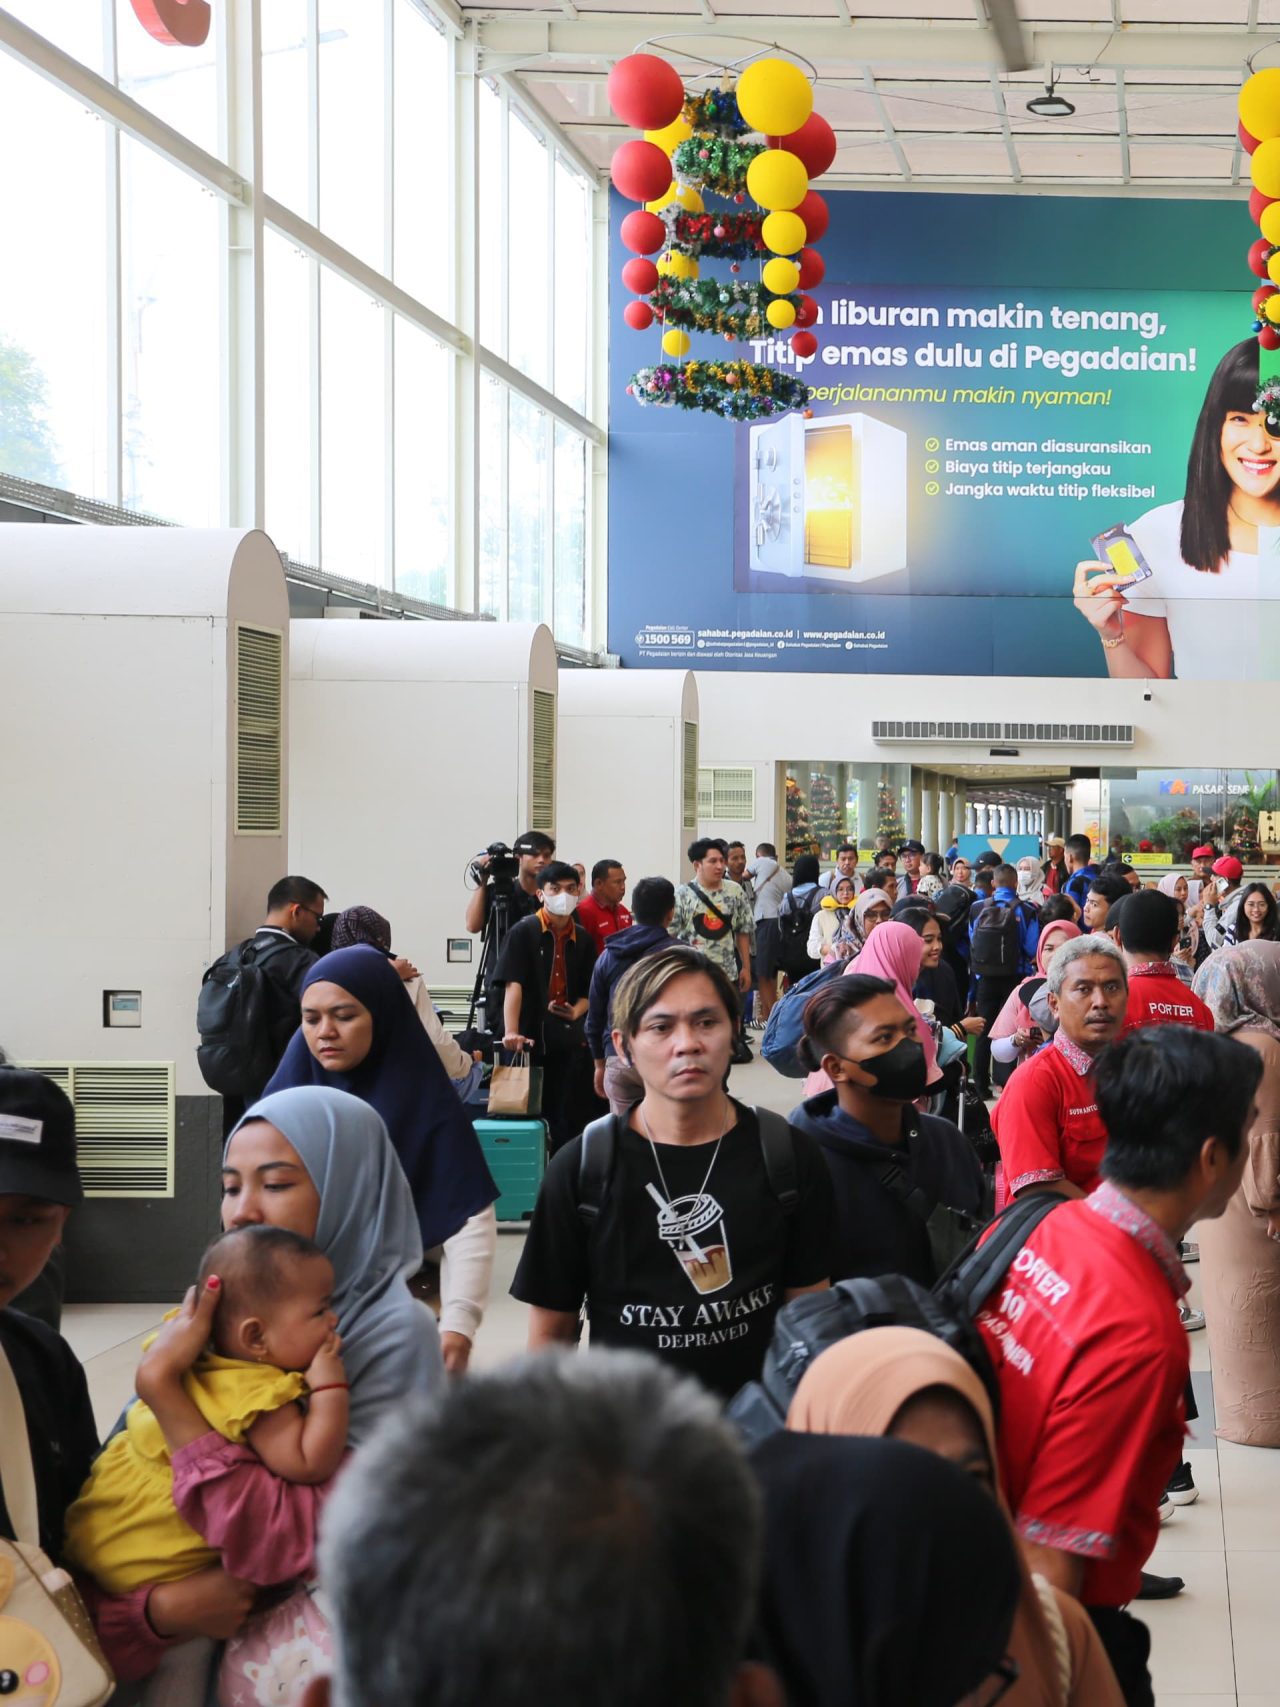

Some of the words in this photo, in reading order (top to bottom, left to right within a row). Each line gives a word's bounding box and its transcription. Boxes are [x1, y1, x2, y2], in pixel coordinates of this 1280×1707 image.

[832, 298, 939, 327] liburan
[947, 302, 1043, 329] makin
[1051, 306, 1167, 339] tenang,
[821, 344, 908, 366] emas
[914, 342, 982, 368] dulu
[989, 342, 1017, 368] di
[1025, 344, 1197, 377] Pegadaian!
[953, 386, 1016, 404] makin
[1022, 389, 1112, 409] nyaman!
[945, 439, 988, 452] Emas
[991, 441, 1038, 452] aman
[1041, 439, 1151, 454] diasuransikan
[945, 460, 989, 477] Biaya
[992, 460, 1023, 477] titip
[1026, 461, 1111, 479] terjangkau
[945, 482, 1003, 499] Jangka
[1007, 483, 1054, 497] waktu
[1058, 483, 1088, 501] titip
[1092, 484, 1155, 498] fleksibel
[645, 634, 671, 645] 1500
[671, 634, 691, 645] 569
[697, 629, 793, 639] sahabat.pegadaian.co.id
[803, 630, 885, 640] www.pegadaian.co.id
[1192, 784, 1224, 795] PASAR
[1148, 1002, 1194, 1018] PORTER
[620, 1304, 685, 1327] STAY
[657, 1322, 749, 1349] DEPRAVED
